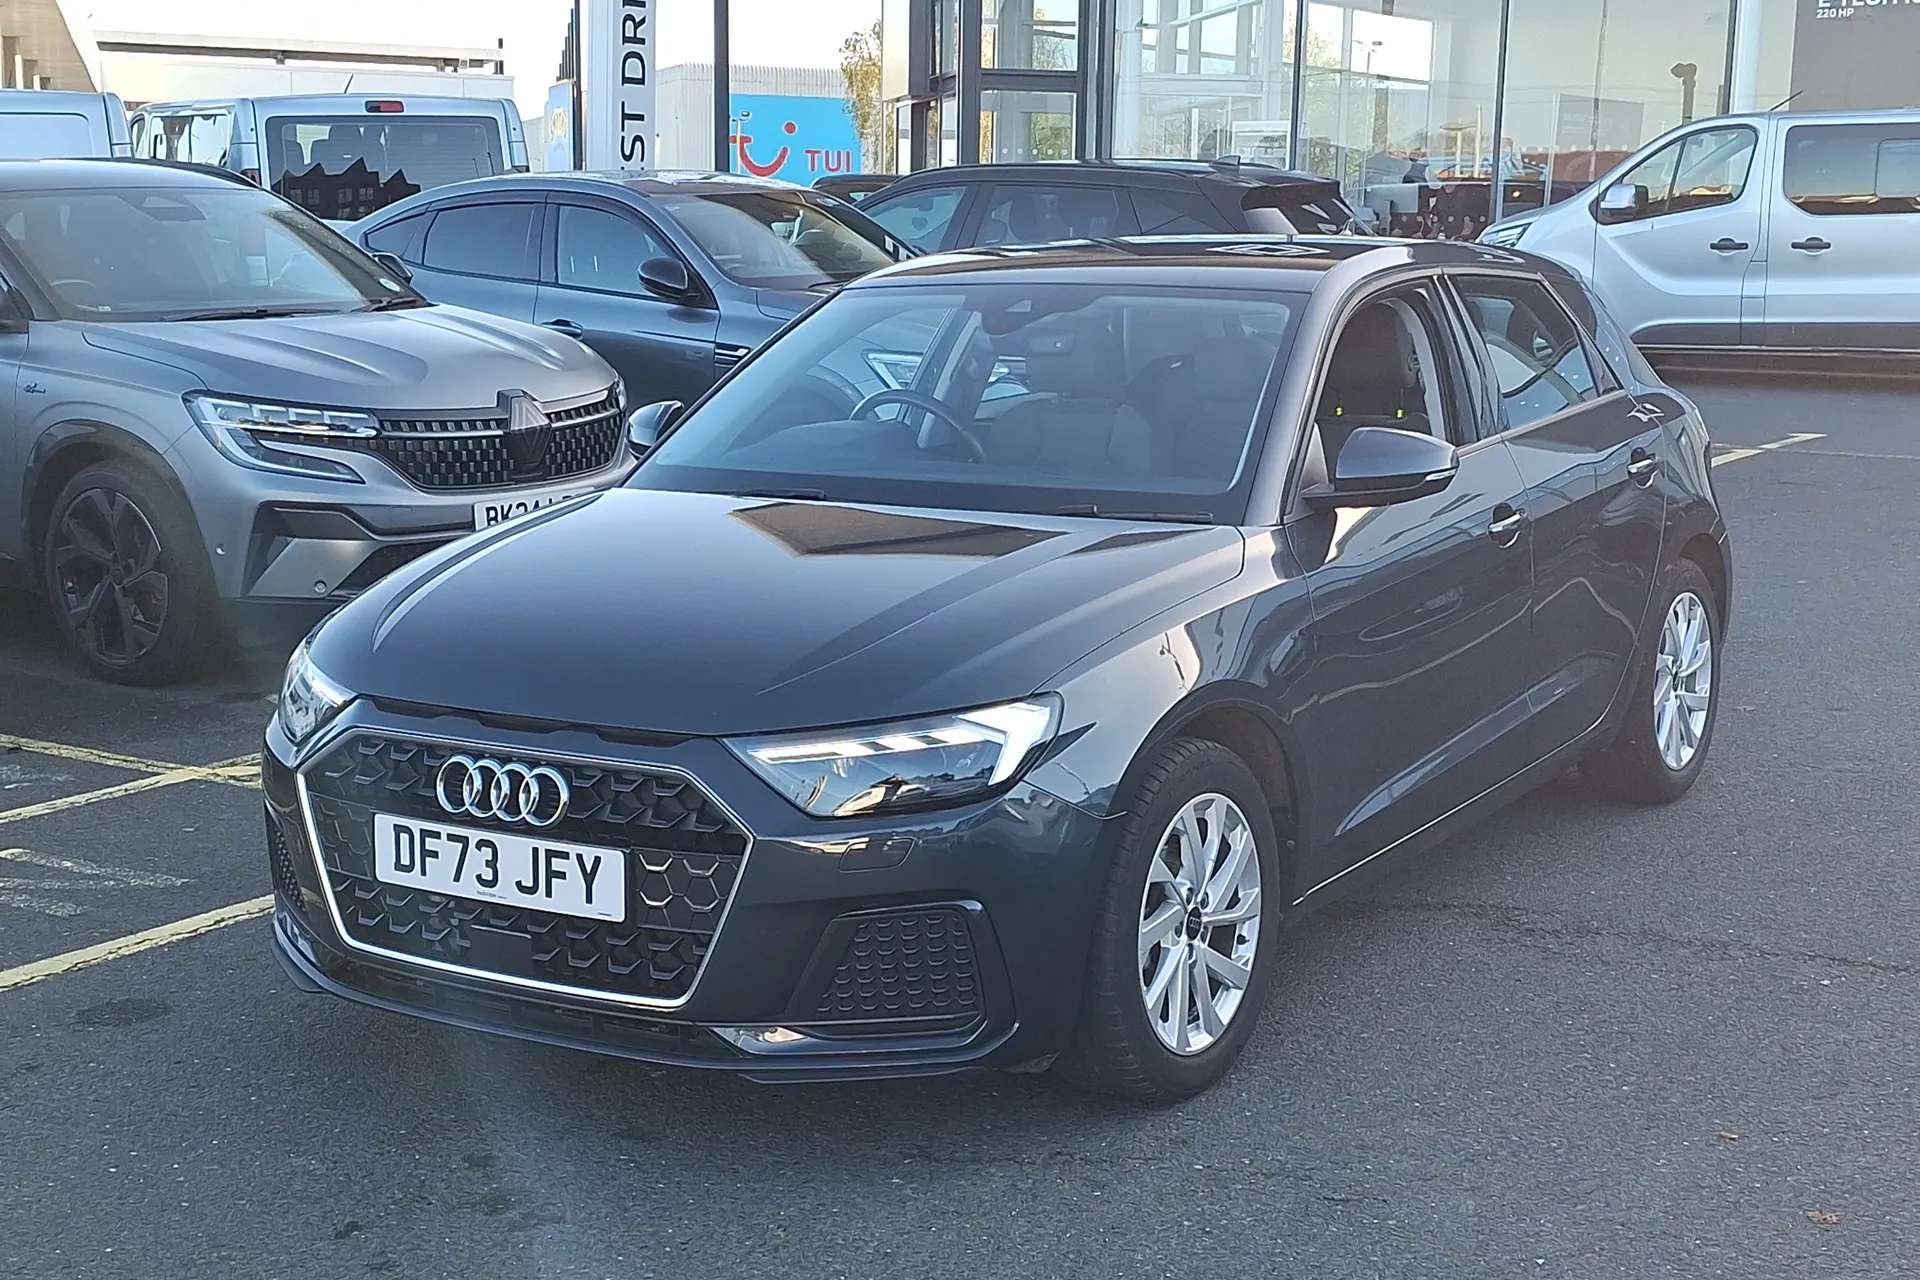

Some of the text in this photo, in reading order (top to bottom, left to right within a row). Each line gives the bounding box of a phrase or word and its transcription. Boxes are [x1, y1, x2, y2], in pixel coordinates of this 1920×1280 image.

[1816, 8, 1854, 18] 220 HP
[620, 101, 646, 171] ST
[804, 149, 851, 172] TUI
[393, 824, 602, 905] DF73 JFY
